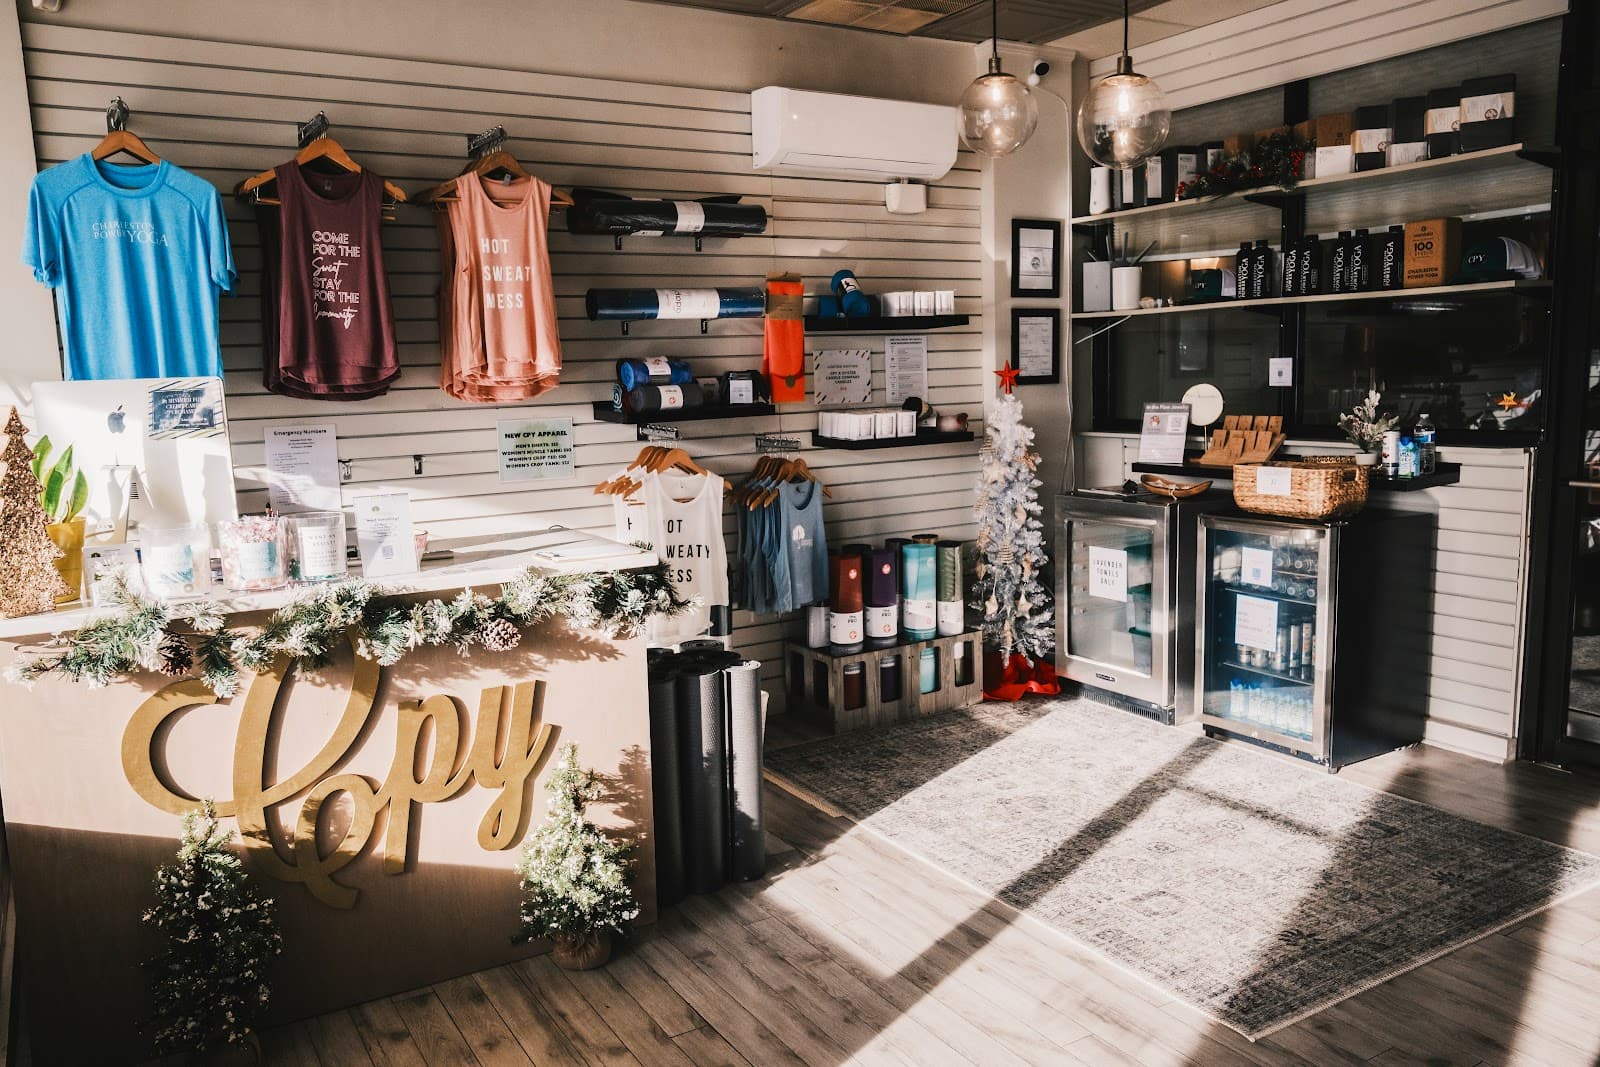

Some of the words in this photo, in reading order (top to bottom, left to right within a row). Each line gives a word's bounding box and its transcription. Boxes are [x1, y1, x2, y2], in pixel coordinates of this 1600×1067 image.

[127, 230, 168, 247] YOGA
[312, 230, 349, 244] COME
[312, 243, 336, 256] FOR
[338, 245, 360, 257] THE
[481, 238, 509, 254] HOT
[1386, 241, 1394, 267] YOGA
[1414, 241, 1433, 251] 100
[1303, 250, 1311, 275] YOGA
[1336, 247, 1344, 273] YOGA
[1353, 245, 1362, 271] YOGA
[482, 265, 531, 281] SWEAT
[1241, 258, 1249, 280] YOGA
[312, 277, 342, 290] STAY
[313, 289, 336, 302] FOR
[338, 291, 360, 303] THE
[486, 293, 524, 309] MESS
[667, 519, 683, 534] OT
[666, 544, 710, 558] WEATY
[669, 569, 693, 582] ESS
